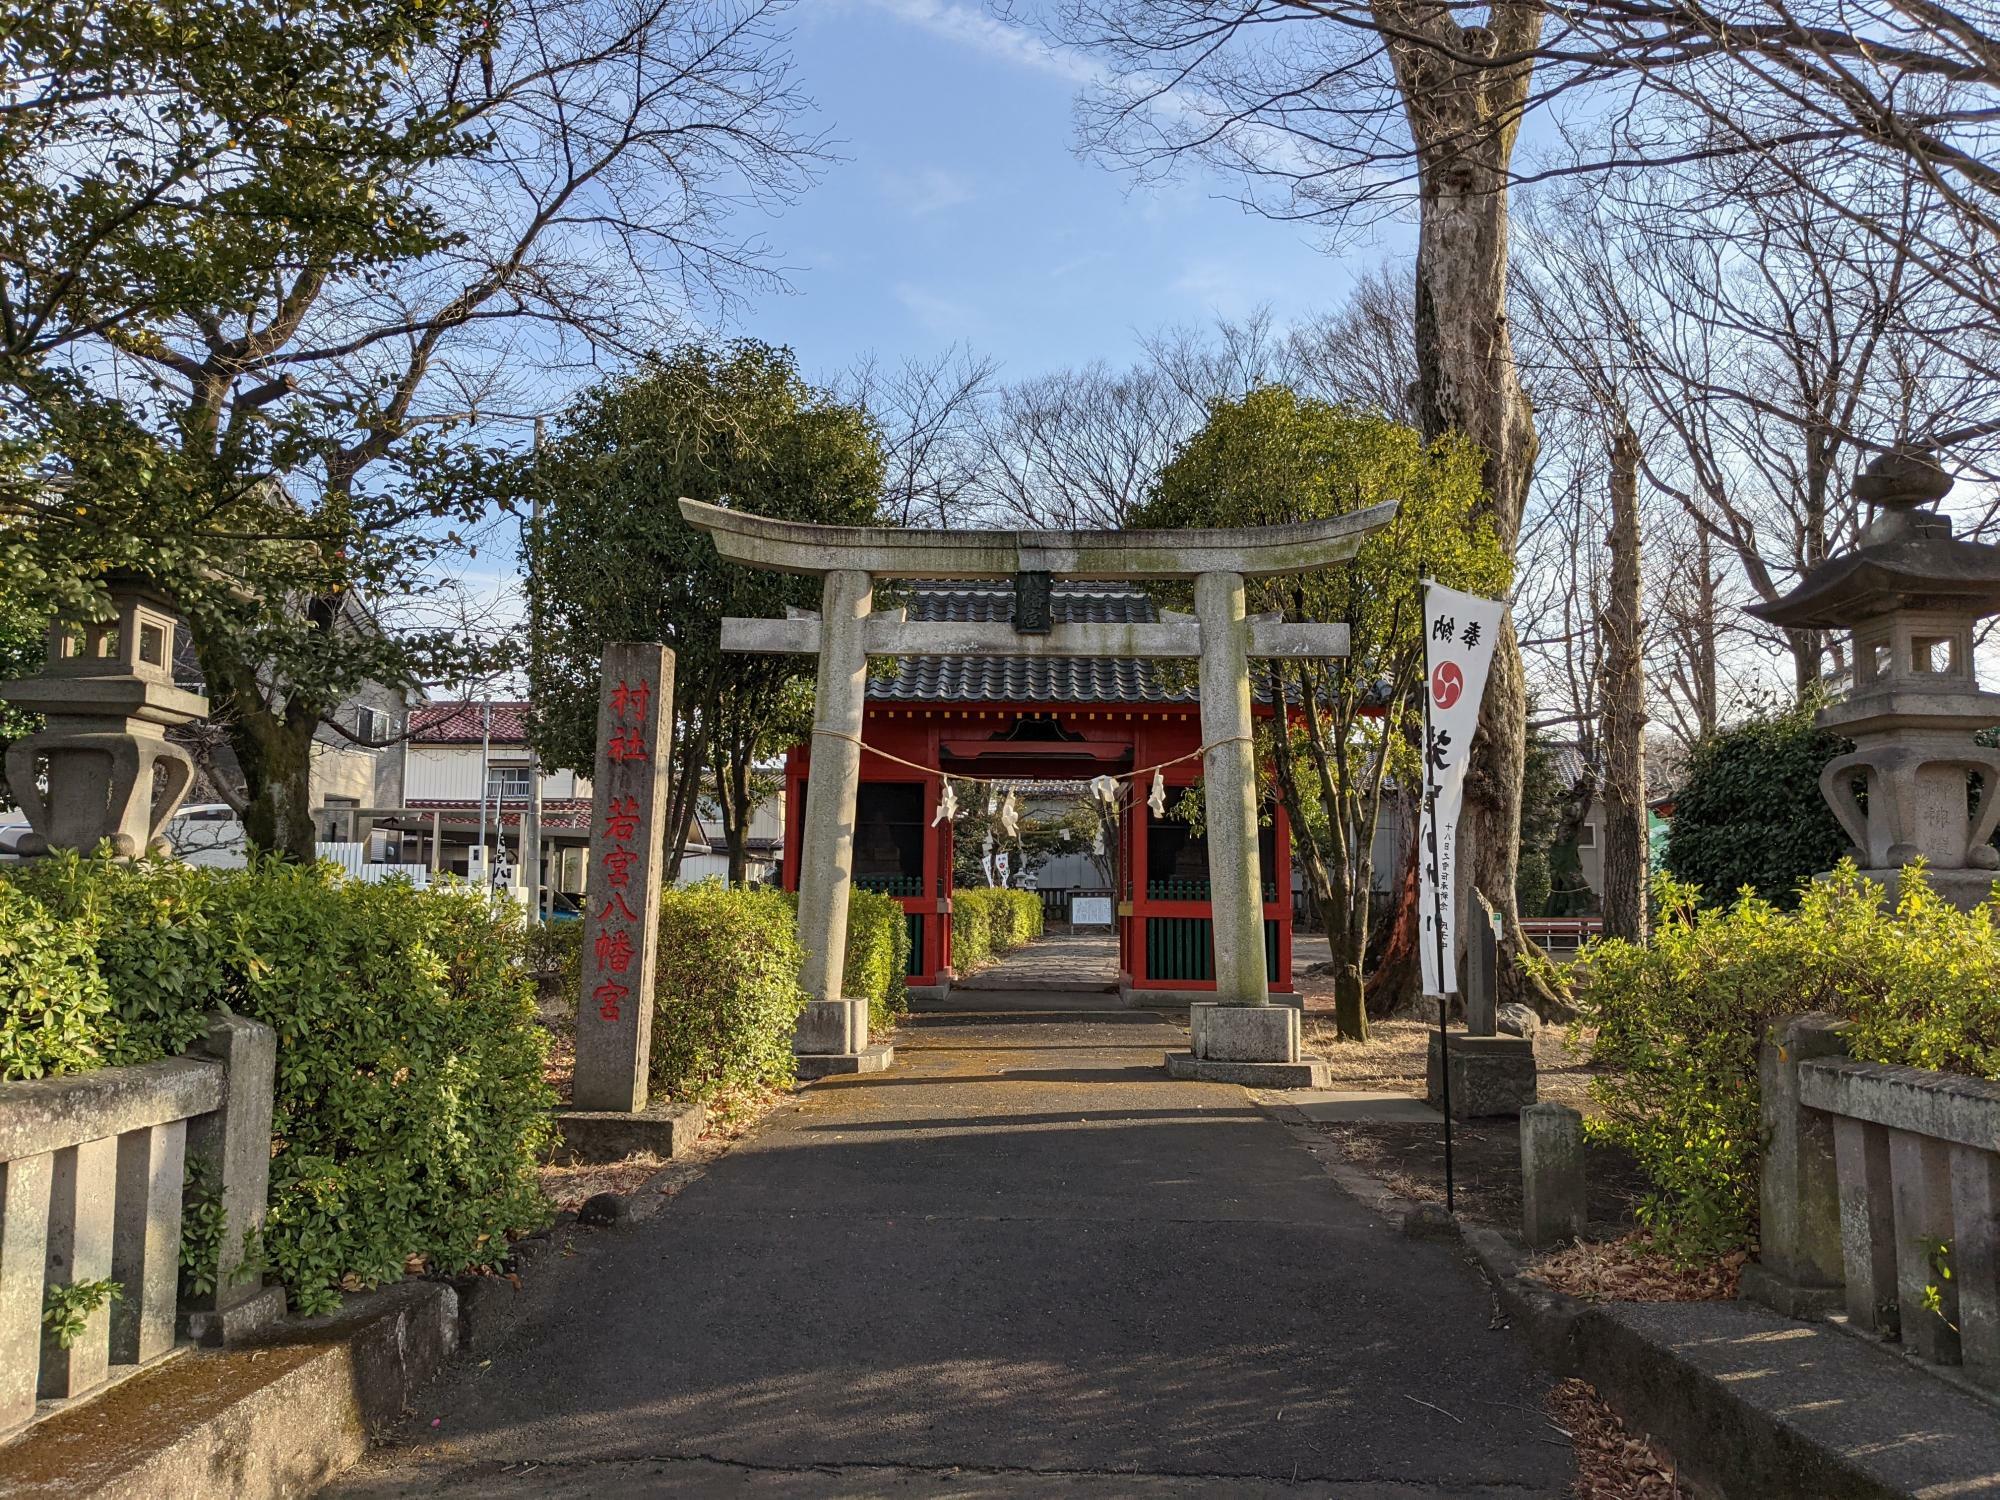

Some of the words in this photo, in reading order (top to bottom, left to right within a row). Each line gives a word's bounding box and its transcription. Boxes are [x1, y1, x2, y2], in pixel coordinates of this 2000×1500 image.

[607, 680, 652, 763] 村社
[592, 798, 641, 1022] 若宮八幡宮
